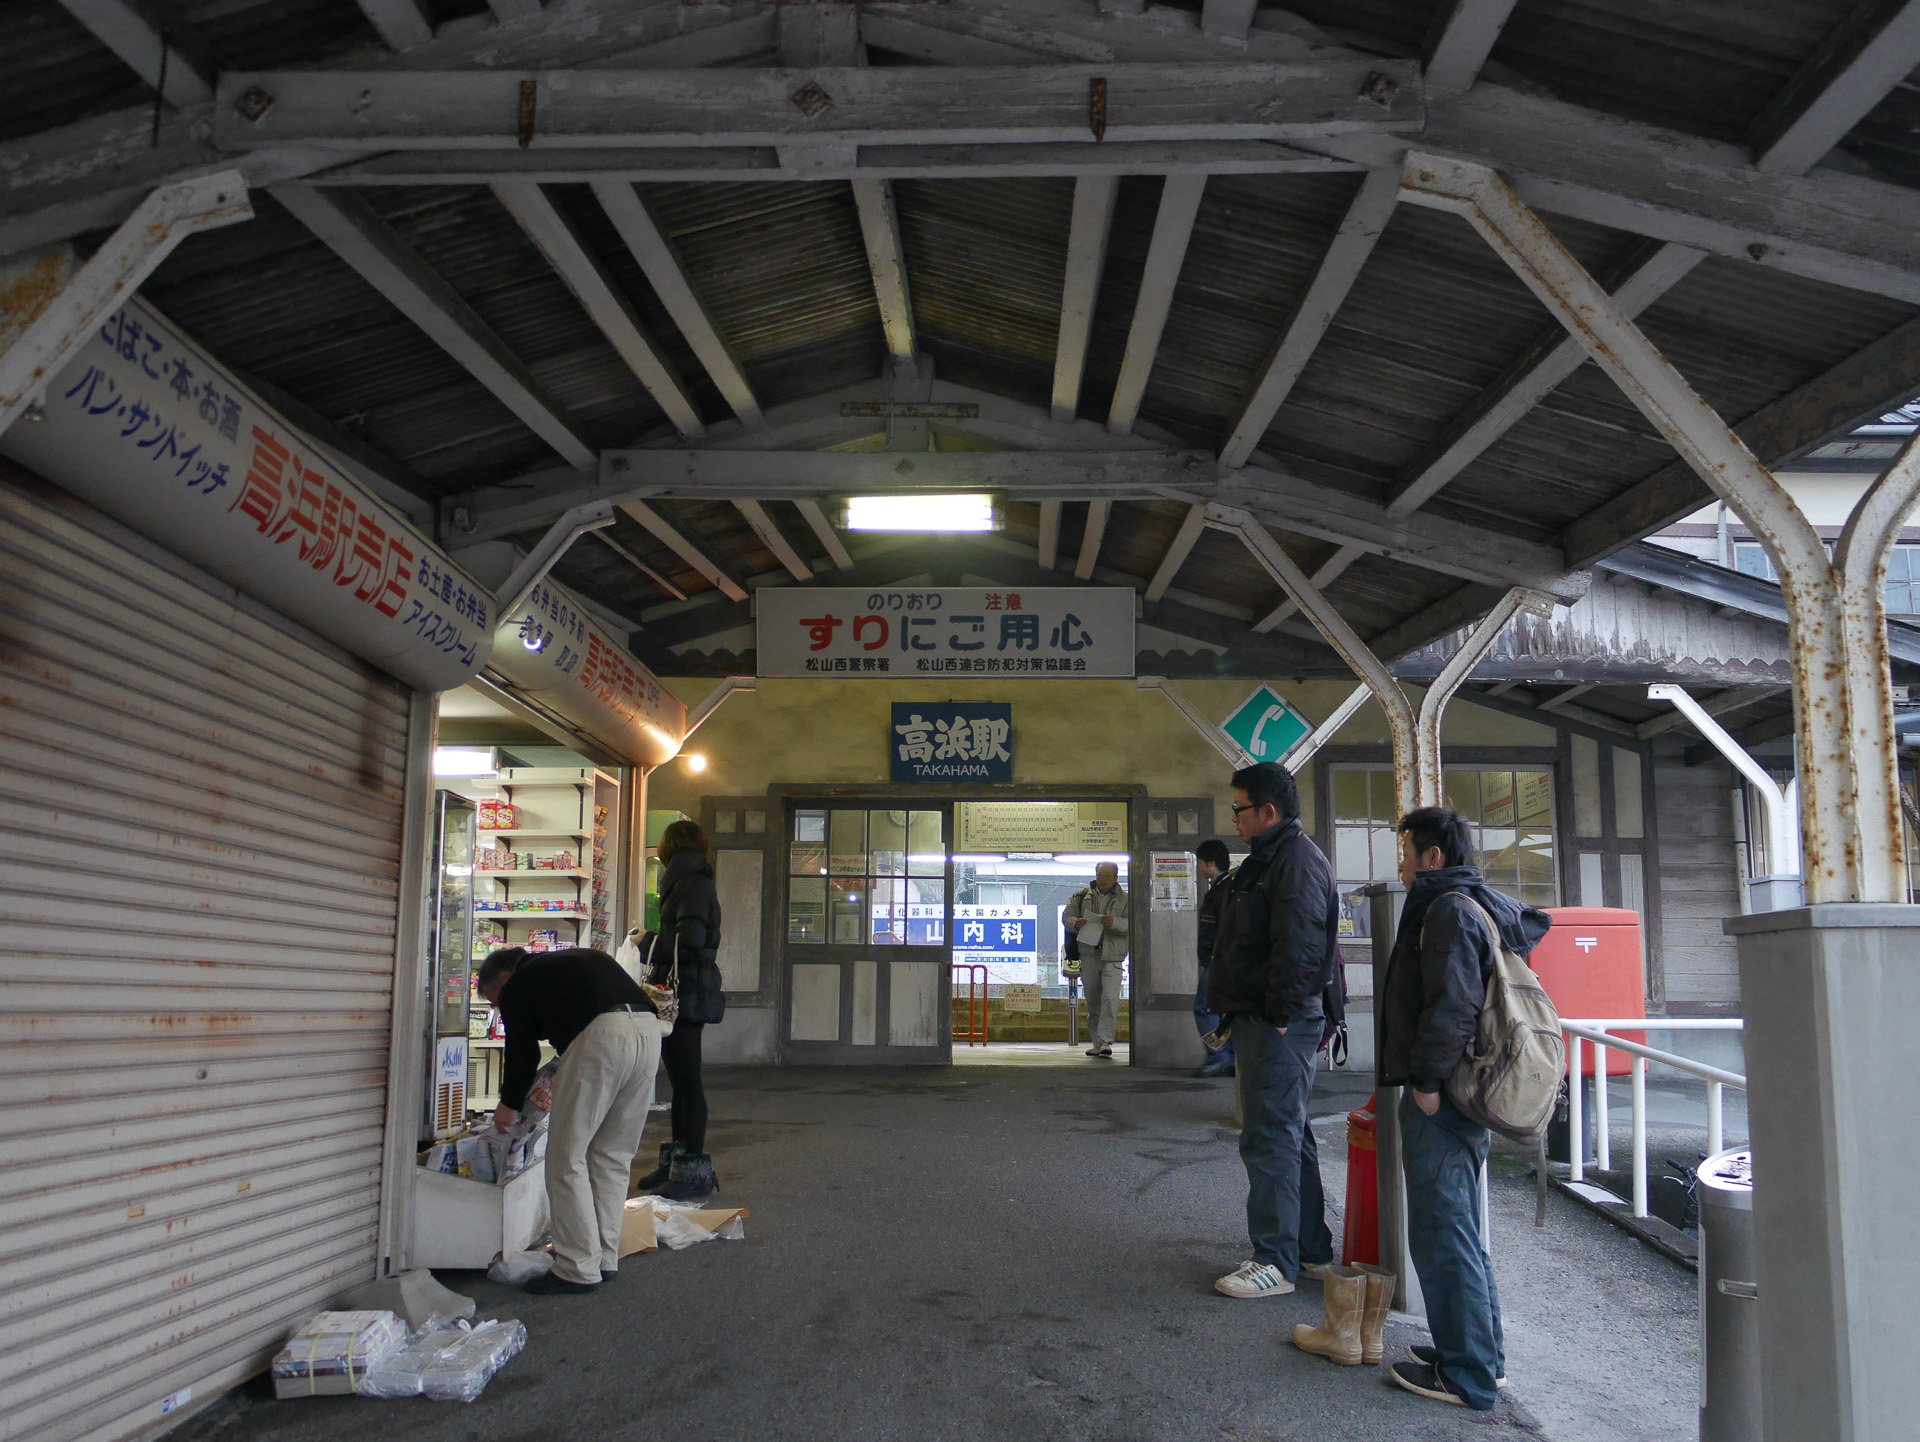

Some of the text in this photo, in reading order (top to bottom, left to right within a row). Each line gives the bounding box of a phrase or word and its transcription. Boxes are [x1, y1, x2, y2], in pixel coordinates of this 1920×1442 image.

[65, 366, 230, 494] パン・サンドイッチ
[227, 424, 414, 618] 高浜駅売店
[418, 555, 487, 631] お土産・お弁当
[867, 592, 1023, 612] のりおり 注意
[403, 599, 478, 667] アイスクリーム
[799, 613, 1094, 652] すりにご用心
[574, 631, 646, 719] 高浜駅売店
[805, 657, 1087, 672] 松山西警察署 松山西連合防犯対策協議会
[895, 714, 1011, 763] 高浜駅
[913, 764, 989, 776] TAKAHAMA
[498, 810, 513, 822] ビスコ
[441, 1045, 463, 1068] Asahi
